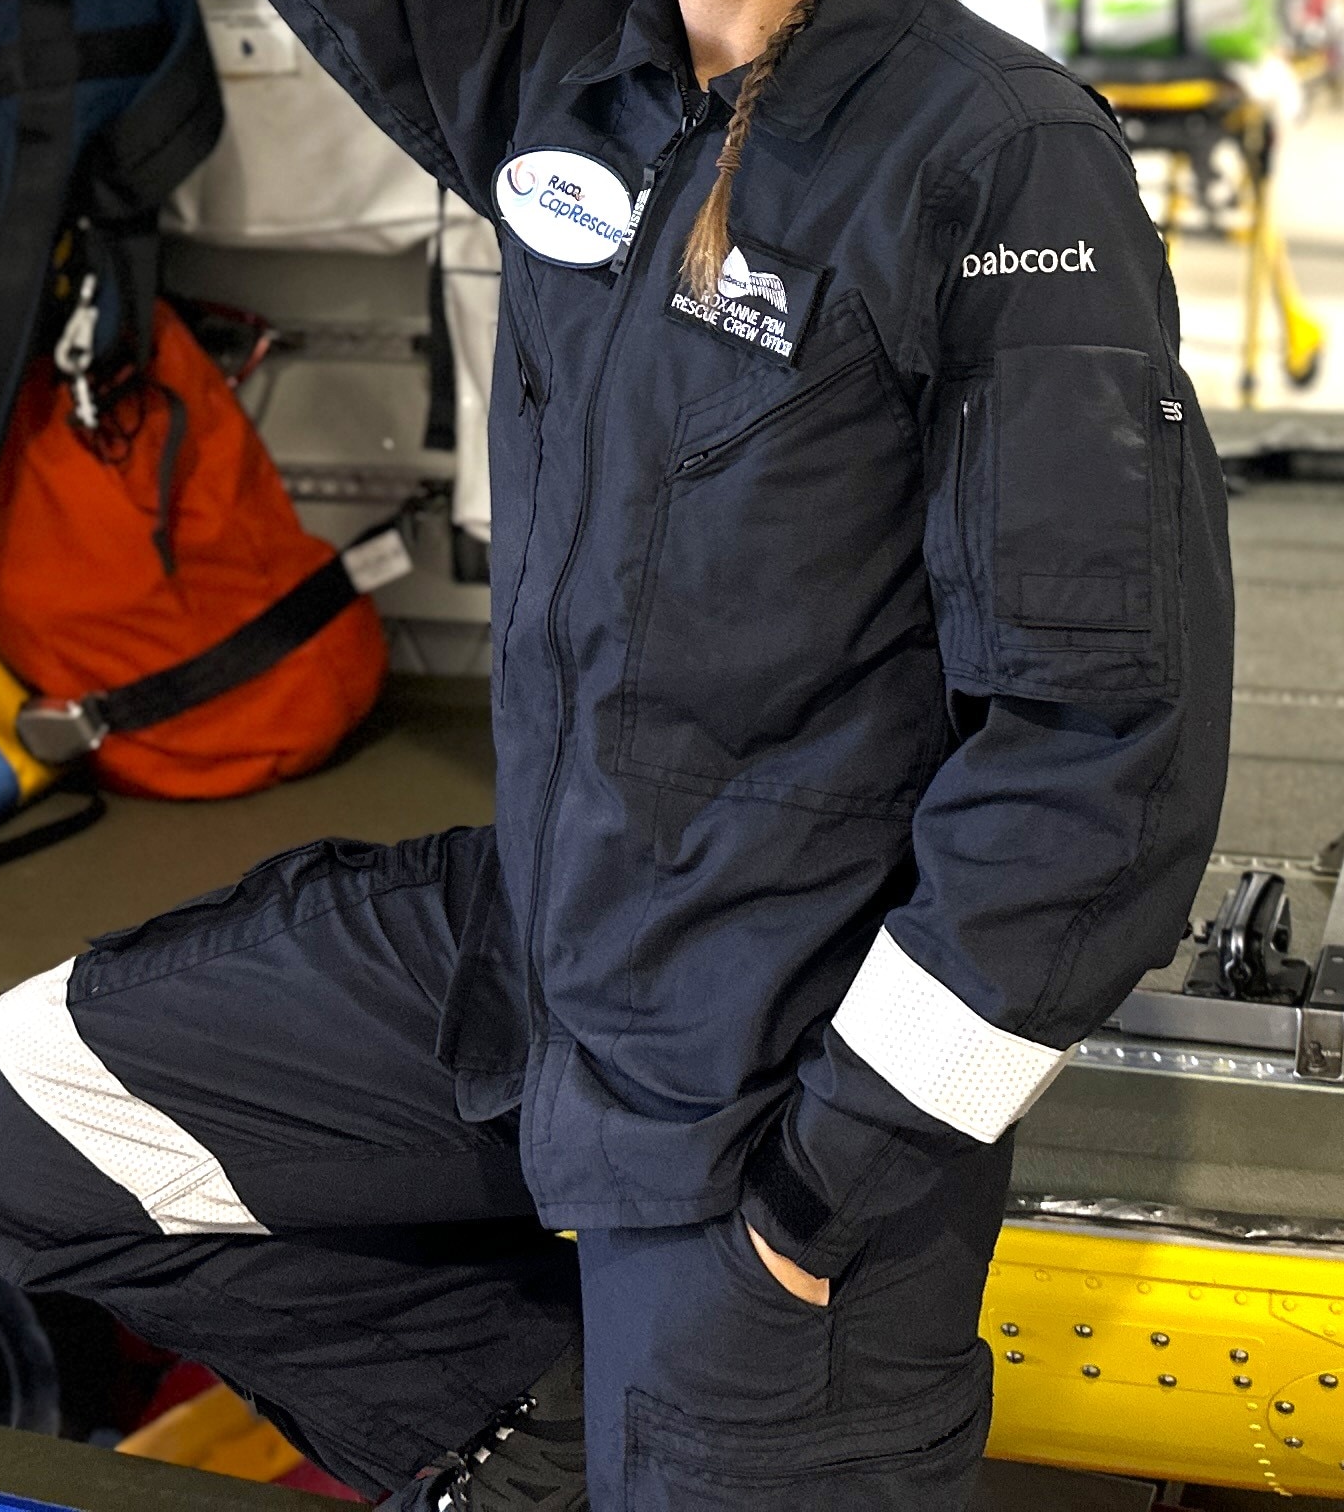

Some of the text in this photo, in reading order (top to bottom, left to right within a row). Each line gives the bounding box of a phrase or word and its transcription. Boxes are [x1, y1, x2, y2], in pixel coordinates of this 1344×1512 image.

[539, 190, 623, 244] CapRescue
[670, 293, 721, 326] RESCUE
[722, 316, 759, 342] CREW
